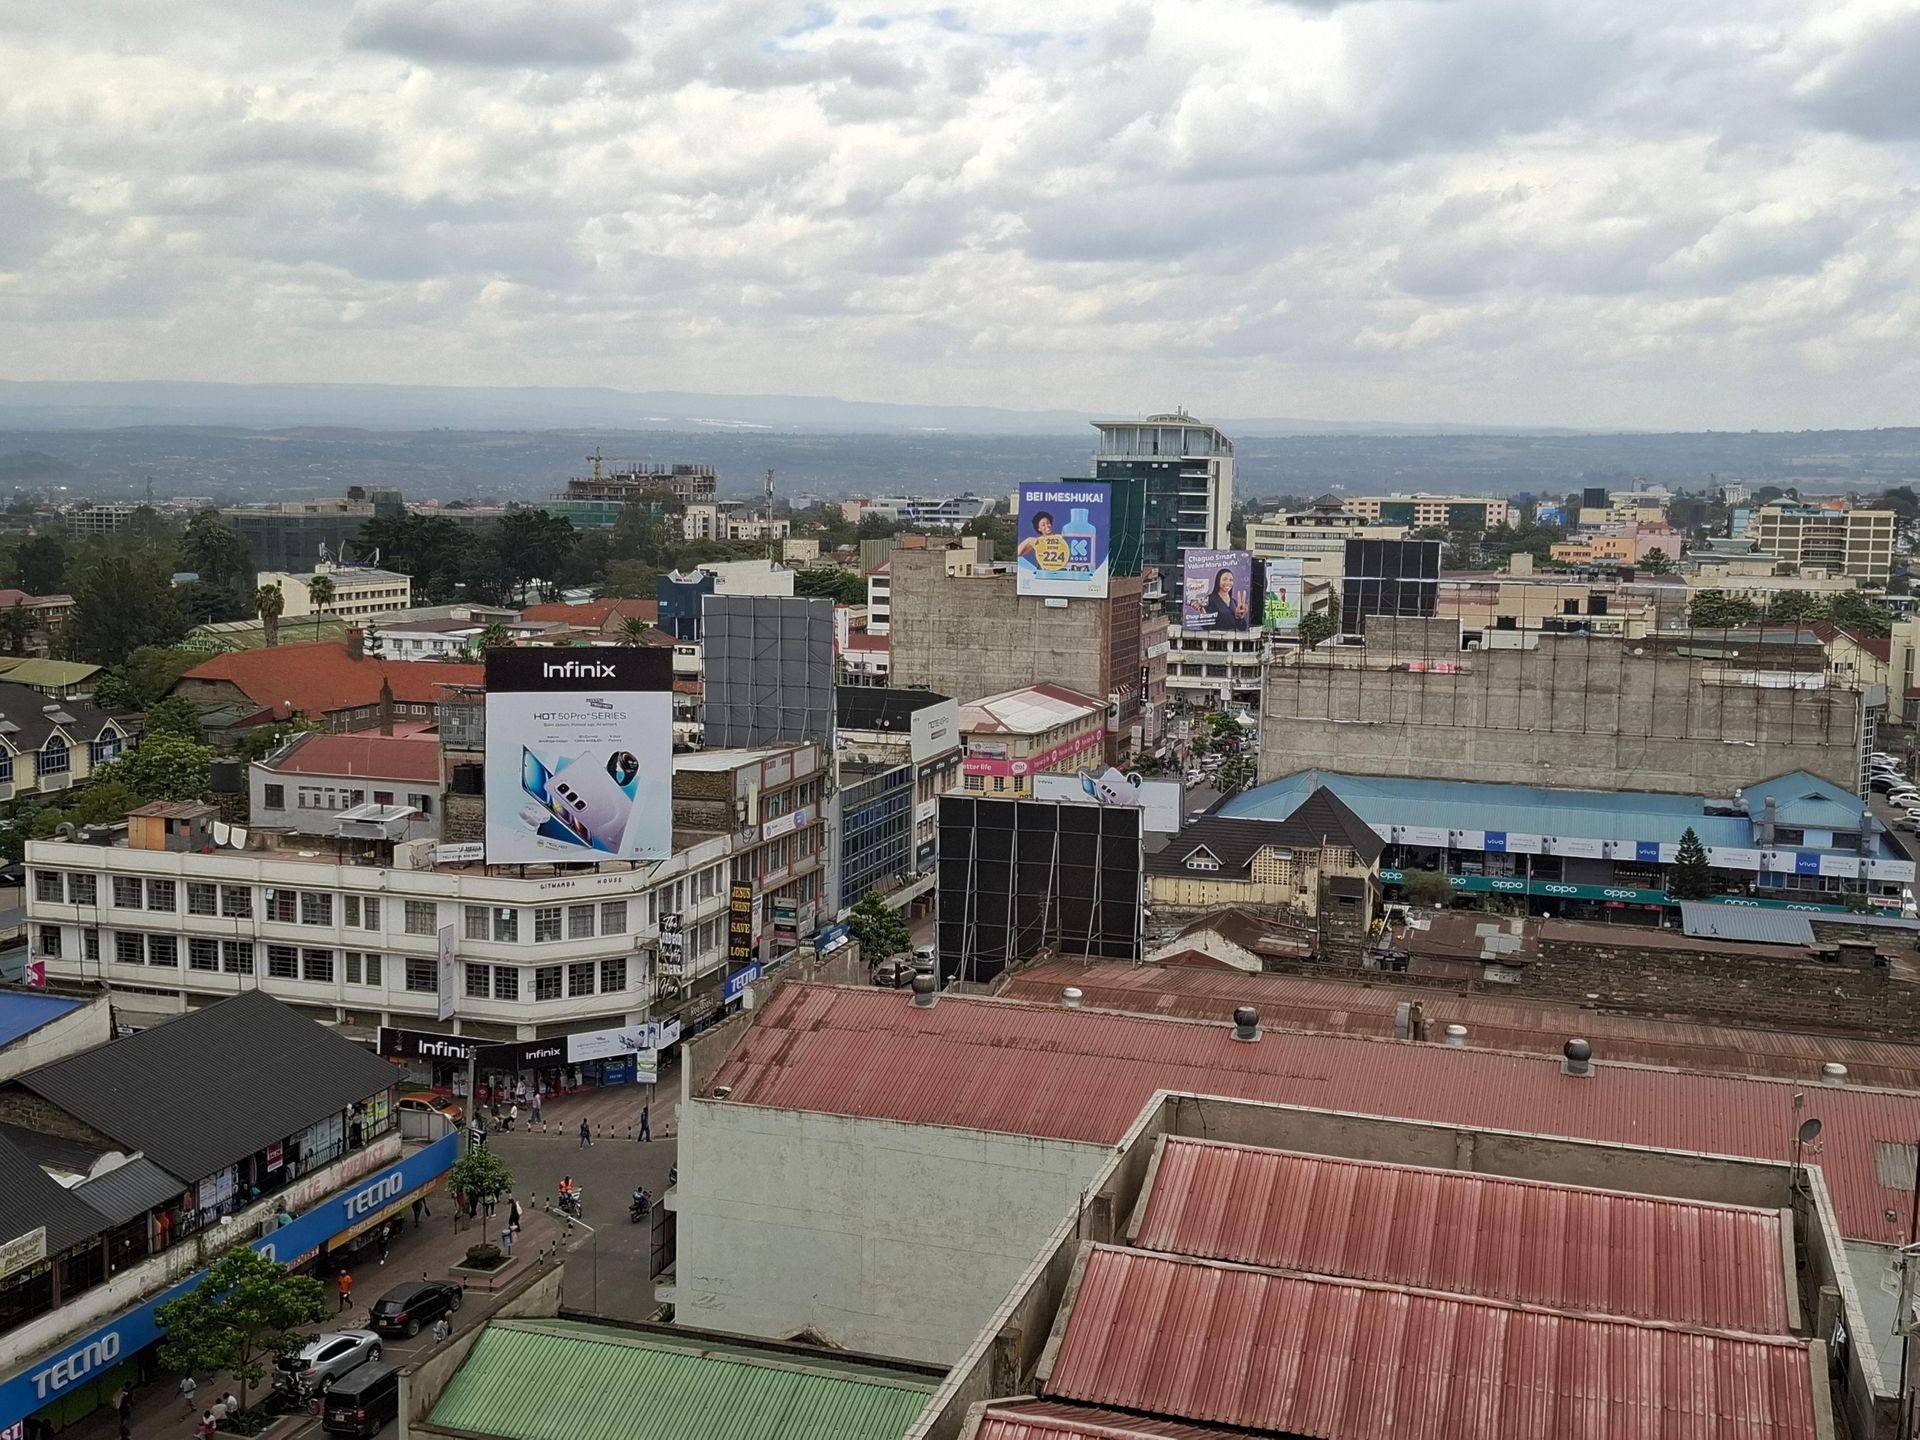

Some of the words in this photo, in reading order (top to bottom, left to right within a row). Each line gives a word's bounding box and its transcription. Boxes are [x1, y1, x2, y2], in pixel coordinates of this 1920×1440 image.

[1026, 492, 1043, 501] BEI
[1045, 493, 1104, 503] IMESHUKA!
[1043, 551, 1065, 562] 224
[1188, 555, 1214, 564] Chaguo
[543, 661, 616, 678] Infinix
[533, 712, 557, 720] HOT
[591, 712, 627, 720] SERIES
[980, 763, 992, 771] life
[1380, 871, 1402, 880] opp
[1492, 880, 1523, 890] oppo
[1545, 884, 1577, 894] oppo
[732, 886, 751, 899] JESUS
[1604, 889, 1637, 899] oppo
[731, 901, 750, 913] CHRIST
[662, 915, 678, 931] The
[730, 922, 750, 934] SAVE
[730, 946, 750, 957] LOST
[730, 966, 757, 993] TECNO
[525, 1046, 561, 1061] Infinix
[343, 1171, 402, 1220] TECNO
[31, 1331, 120, 1400] TECNO
